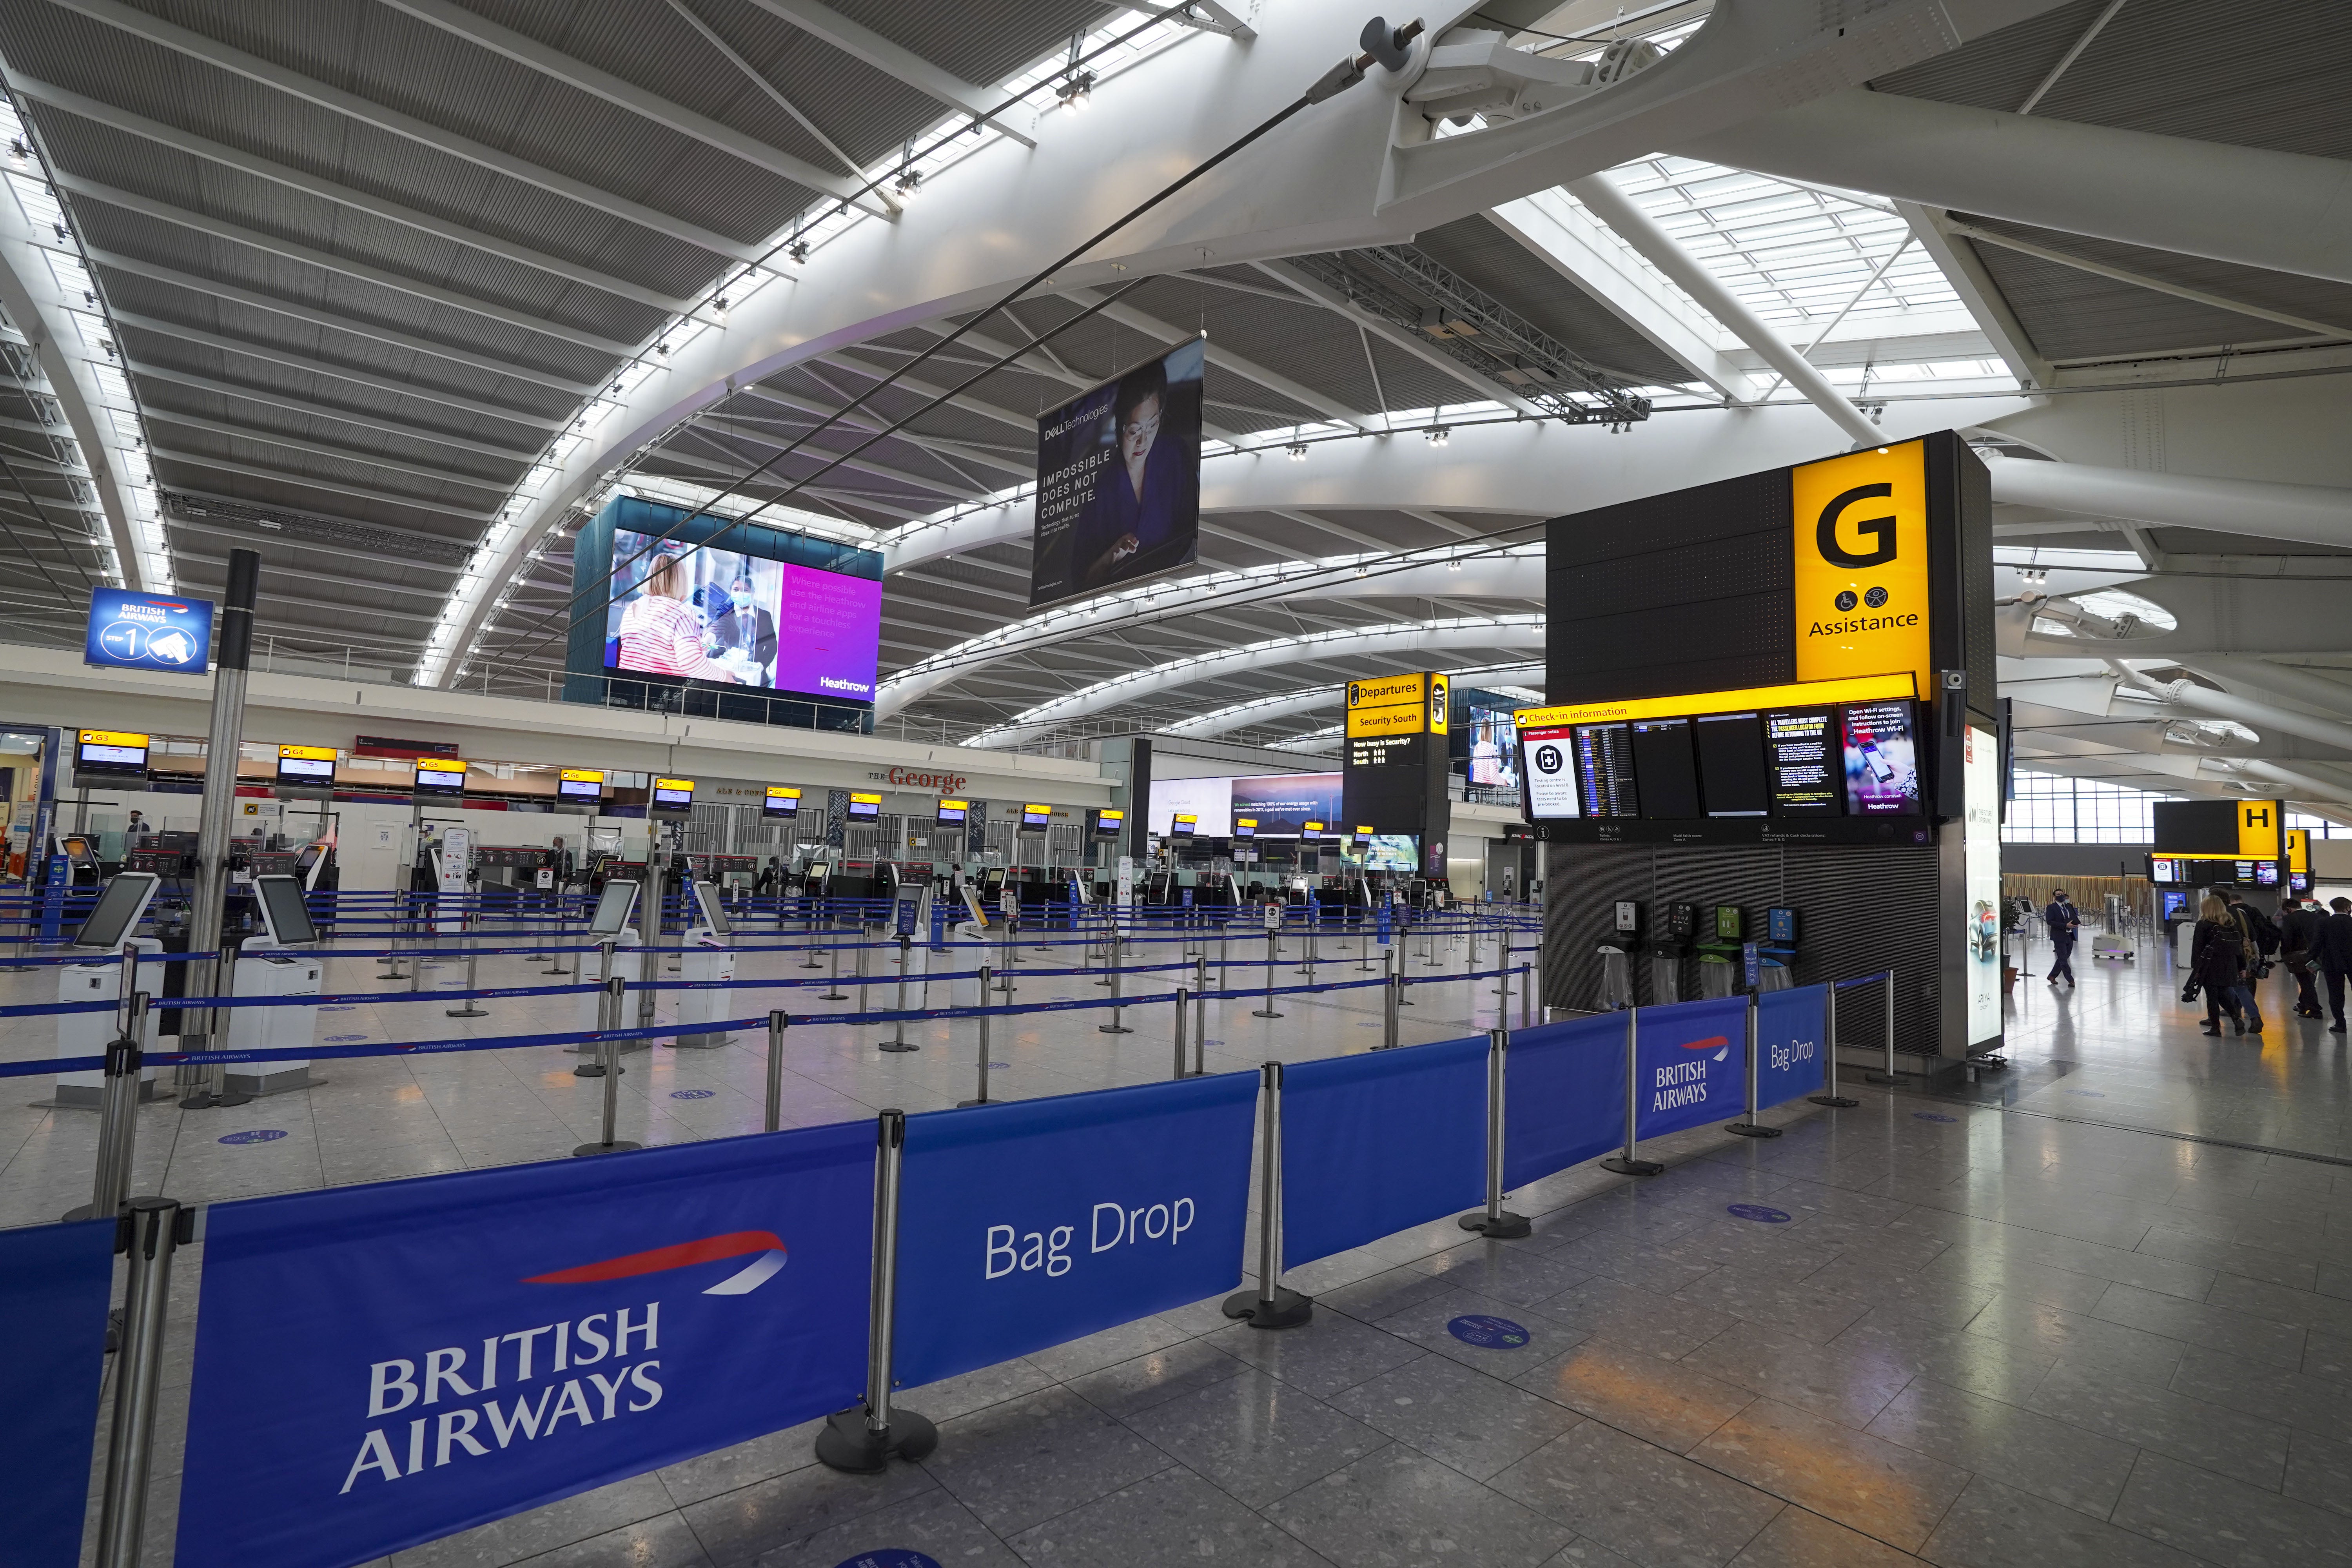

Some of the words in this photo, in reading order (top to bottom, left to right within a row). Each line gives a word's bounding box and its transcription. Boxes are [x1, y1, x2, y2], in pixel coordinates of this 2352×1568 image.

[1045, 423, 1064, 441] DELL
[1064, 404, 1108, 431] Technologies
[1043, 449, 1110, 488] IMPOSSIBLE
[1042, 483, 1069, 504] DOES
[1074, 471, 1097, 490] NOT
[1041, 489, 1096, 519] COMPUTE.
[1041, 520, 1061, 530] Technology
[1816, 483, 1897, 569] G
[791, 575, 820, 589] Where
[822, 583, 856, 595] possible
[790, 588, 806, 597] use
[808, 591, 822, 601] the
[824, 594, 866, 609] Heathrow
[118, 612, 167, 624] AIRWAYS
[122, 604, 165, 616] BRITISH
[789, 601, 806, 610] and
[808, 603, 835, 615] airline
[837, 609, 857, 619] apps
[789, 612, 802, 621] for
[811, 615, 851, 629] touchless
[788, 624, 835, 638] experience
[1808, 614, 1918, 637] Assistance
[125, 628, 136, 655] 1
[820, 676, 869, 693] Heathrow
[1361, 684, 1417, 699] Departures
[1360, 716, 1391, 726] Security
[1393, 713, 1417, 723] South
[1529, 711, 1568, 722] Check-in
[1570, 707, 1627, 719] information
[889, 767, 966, 795] George
[2246, 808, 2268, 828] H
[1978, 992, 1991, 1004] ARIYA
[1771, 1044, 1790, 1071] Bag
[1792, 1039, 1813, 1063] Drop
[1656, 1060, 1706, 1088] BRITISH
[1652, 1082, 1707, 1112] AIRWAYS
[985, 1224, 1074, 1280] Bag
[1091, 1197, 1195, 1254] Drop
[366, 1301, 660, 1419] BRITISH
[338, 1360, 663, 1495] AIRWAYS
